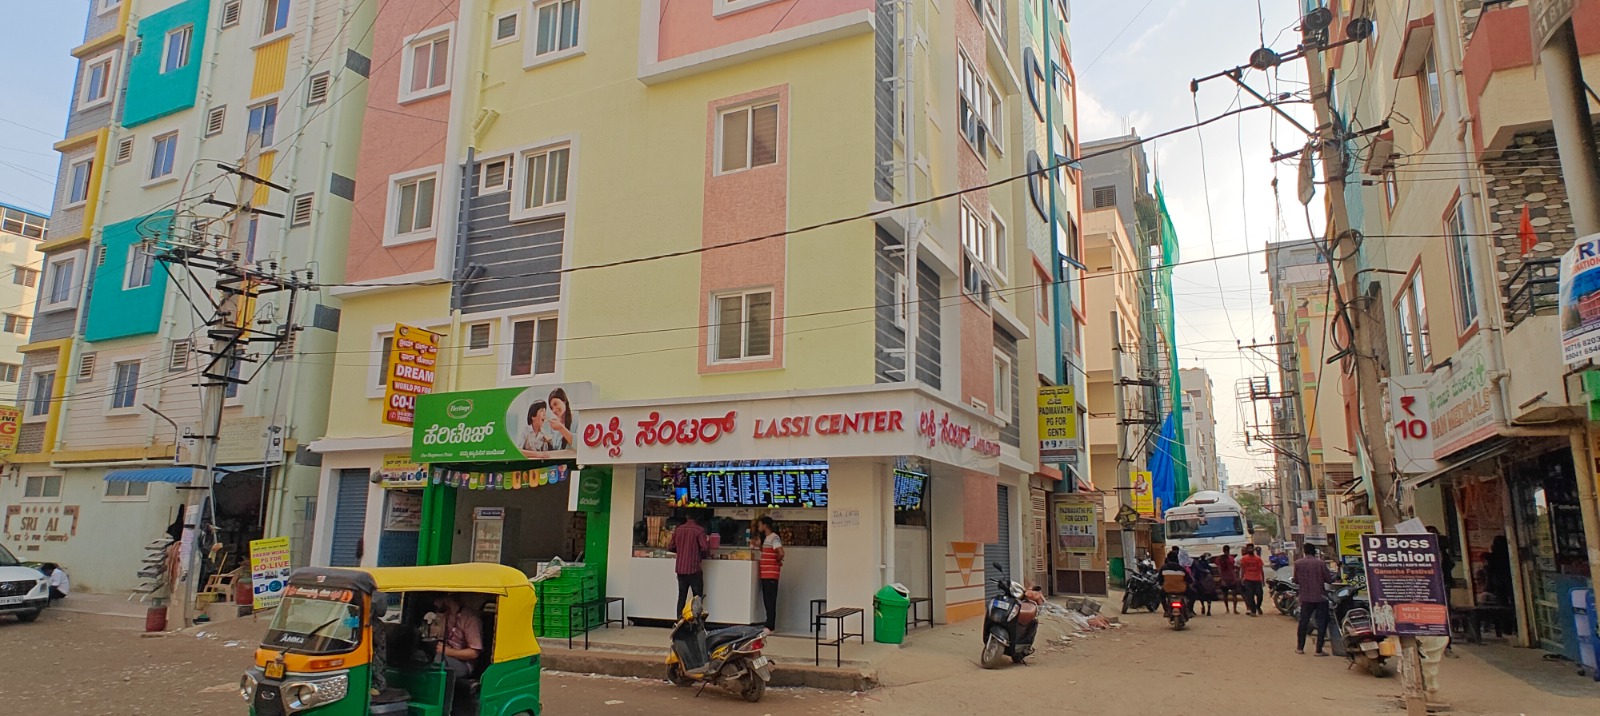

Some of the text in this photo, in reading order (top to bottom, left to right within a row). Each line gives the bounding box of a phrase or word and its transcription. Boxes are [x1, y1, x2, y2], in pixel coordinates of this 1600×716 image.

[396, 364, 435, 383] DREAM
[394, 381, 413, 392] WORLD
[413, 385, 421, 393] PG
[391, 394, 415, 409] CO-L
[1039, 405, 1073, 415] PADMAVATHI
[1447, 387, 1491, 431] MEDICALS
[0, 421, 17, 435] G
[752, 410, 906, 440] LASSI CENTER
[1046, 416, 1067, 426] PG FOR
[423, 421, 496, 445] ಹೆರಿಟೇಜ್
[583, 411, 737, 459] ಲಸ್ಸಿ ಸೆಂಟರ್
[1048, 428, 1066, 437] GENTS
[1394, 419, 1428, 440] 10
[20, 516, 39, 531] SRI
[1368, 537, 1430, 549] D Boss
[1366, 550, 1436, 563] Fashion
[253, 560, 290, 571] CO-LIVE
